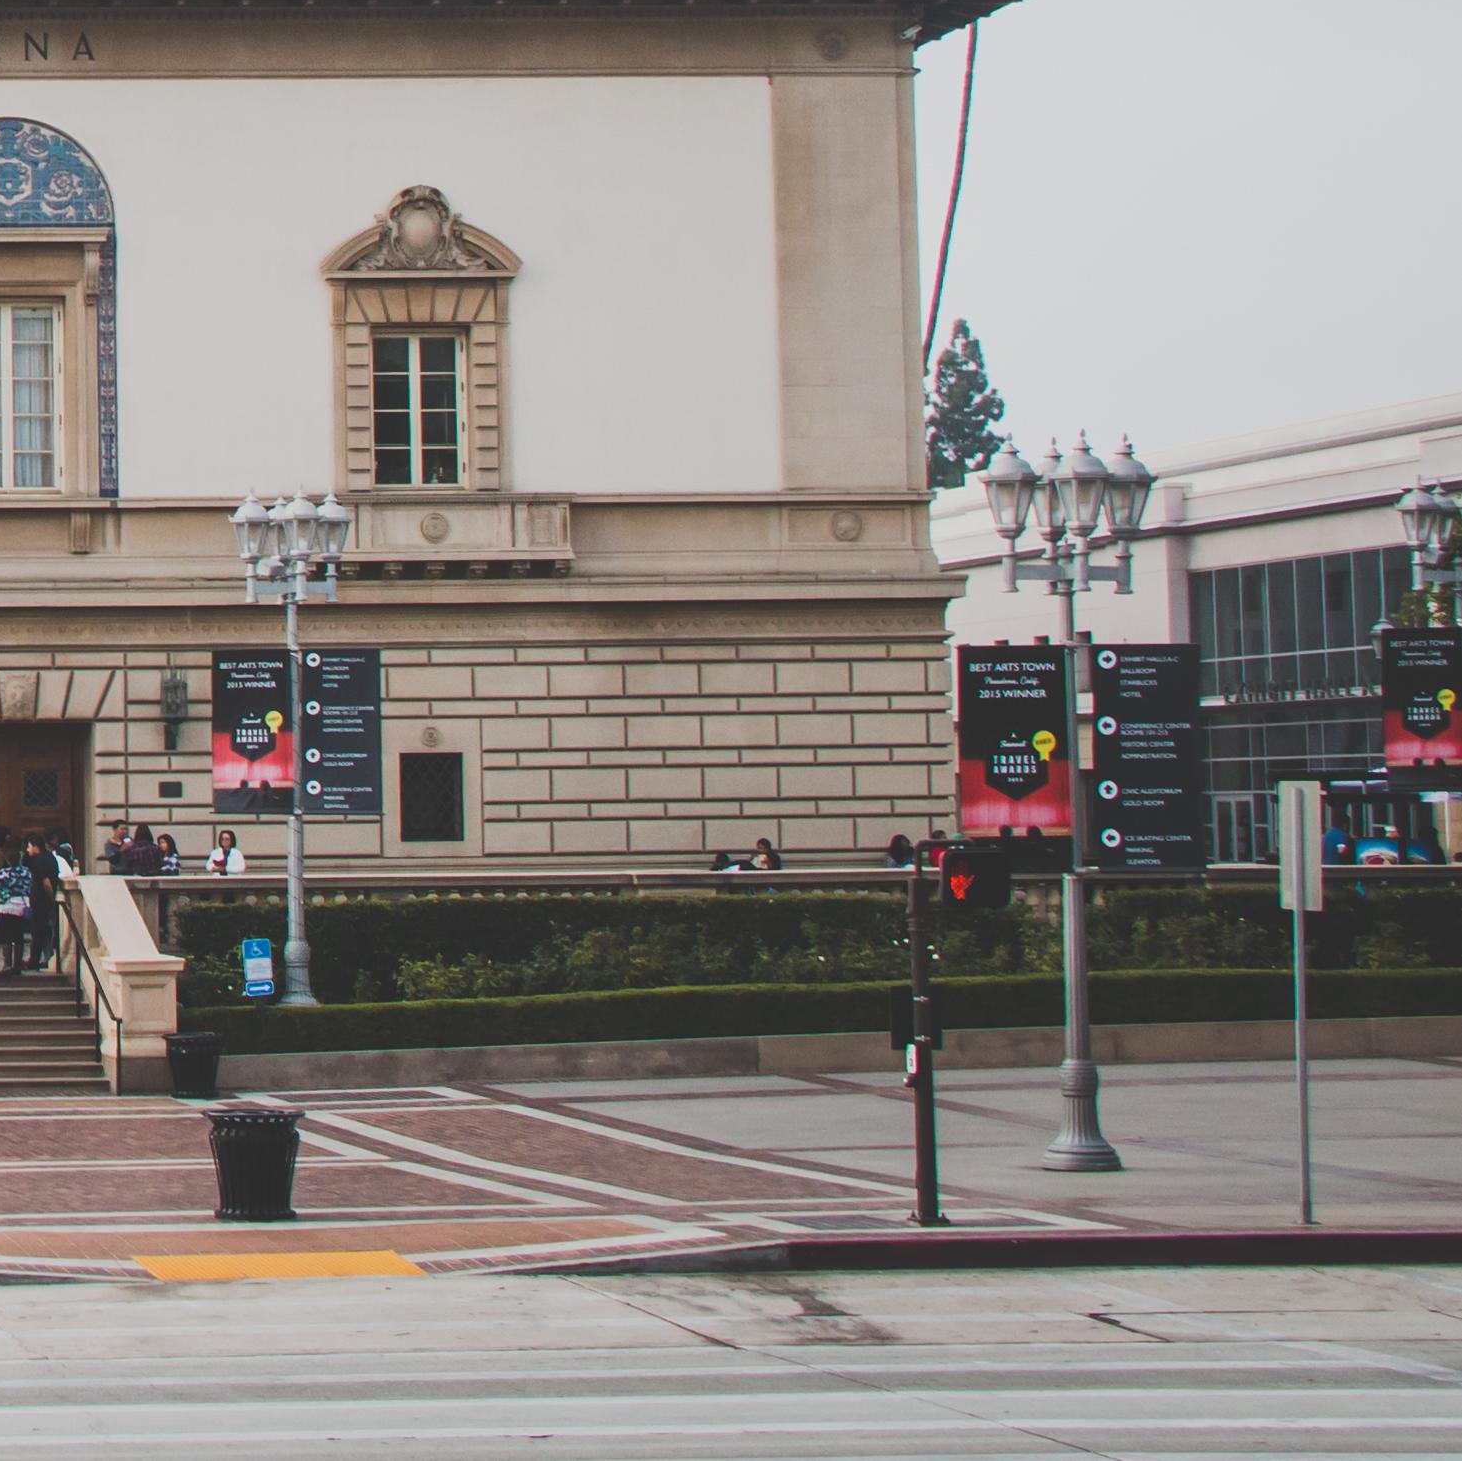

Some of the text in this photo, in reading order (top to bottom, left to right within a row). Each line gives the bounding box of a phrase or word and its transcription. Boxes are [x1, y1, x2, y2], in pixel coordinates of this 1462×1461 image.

[969, 662, 1055, 672] BEST ARTS TOWN
[979, 689, 1046, 698] 2015 WINNER
[993, 755, 1036, 764] TRAVEL
[993, 765, 1036, 774] AWARDS
